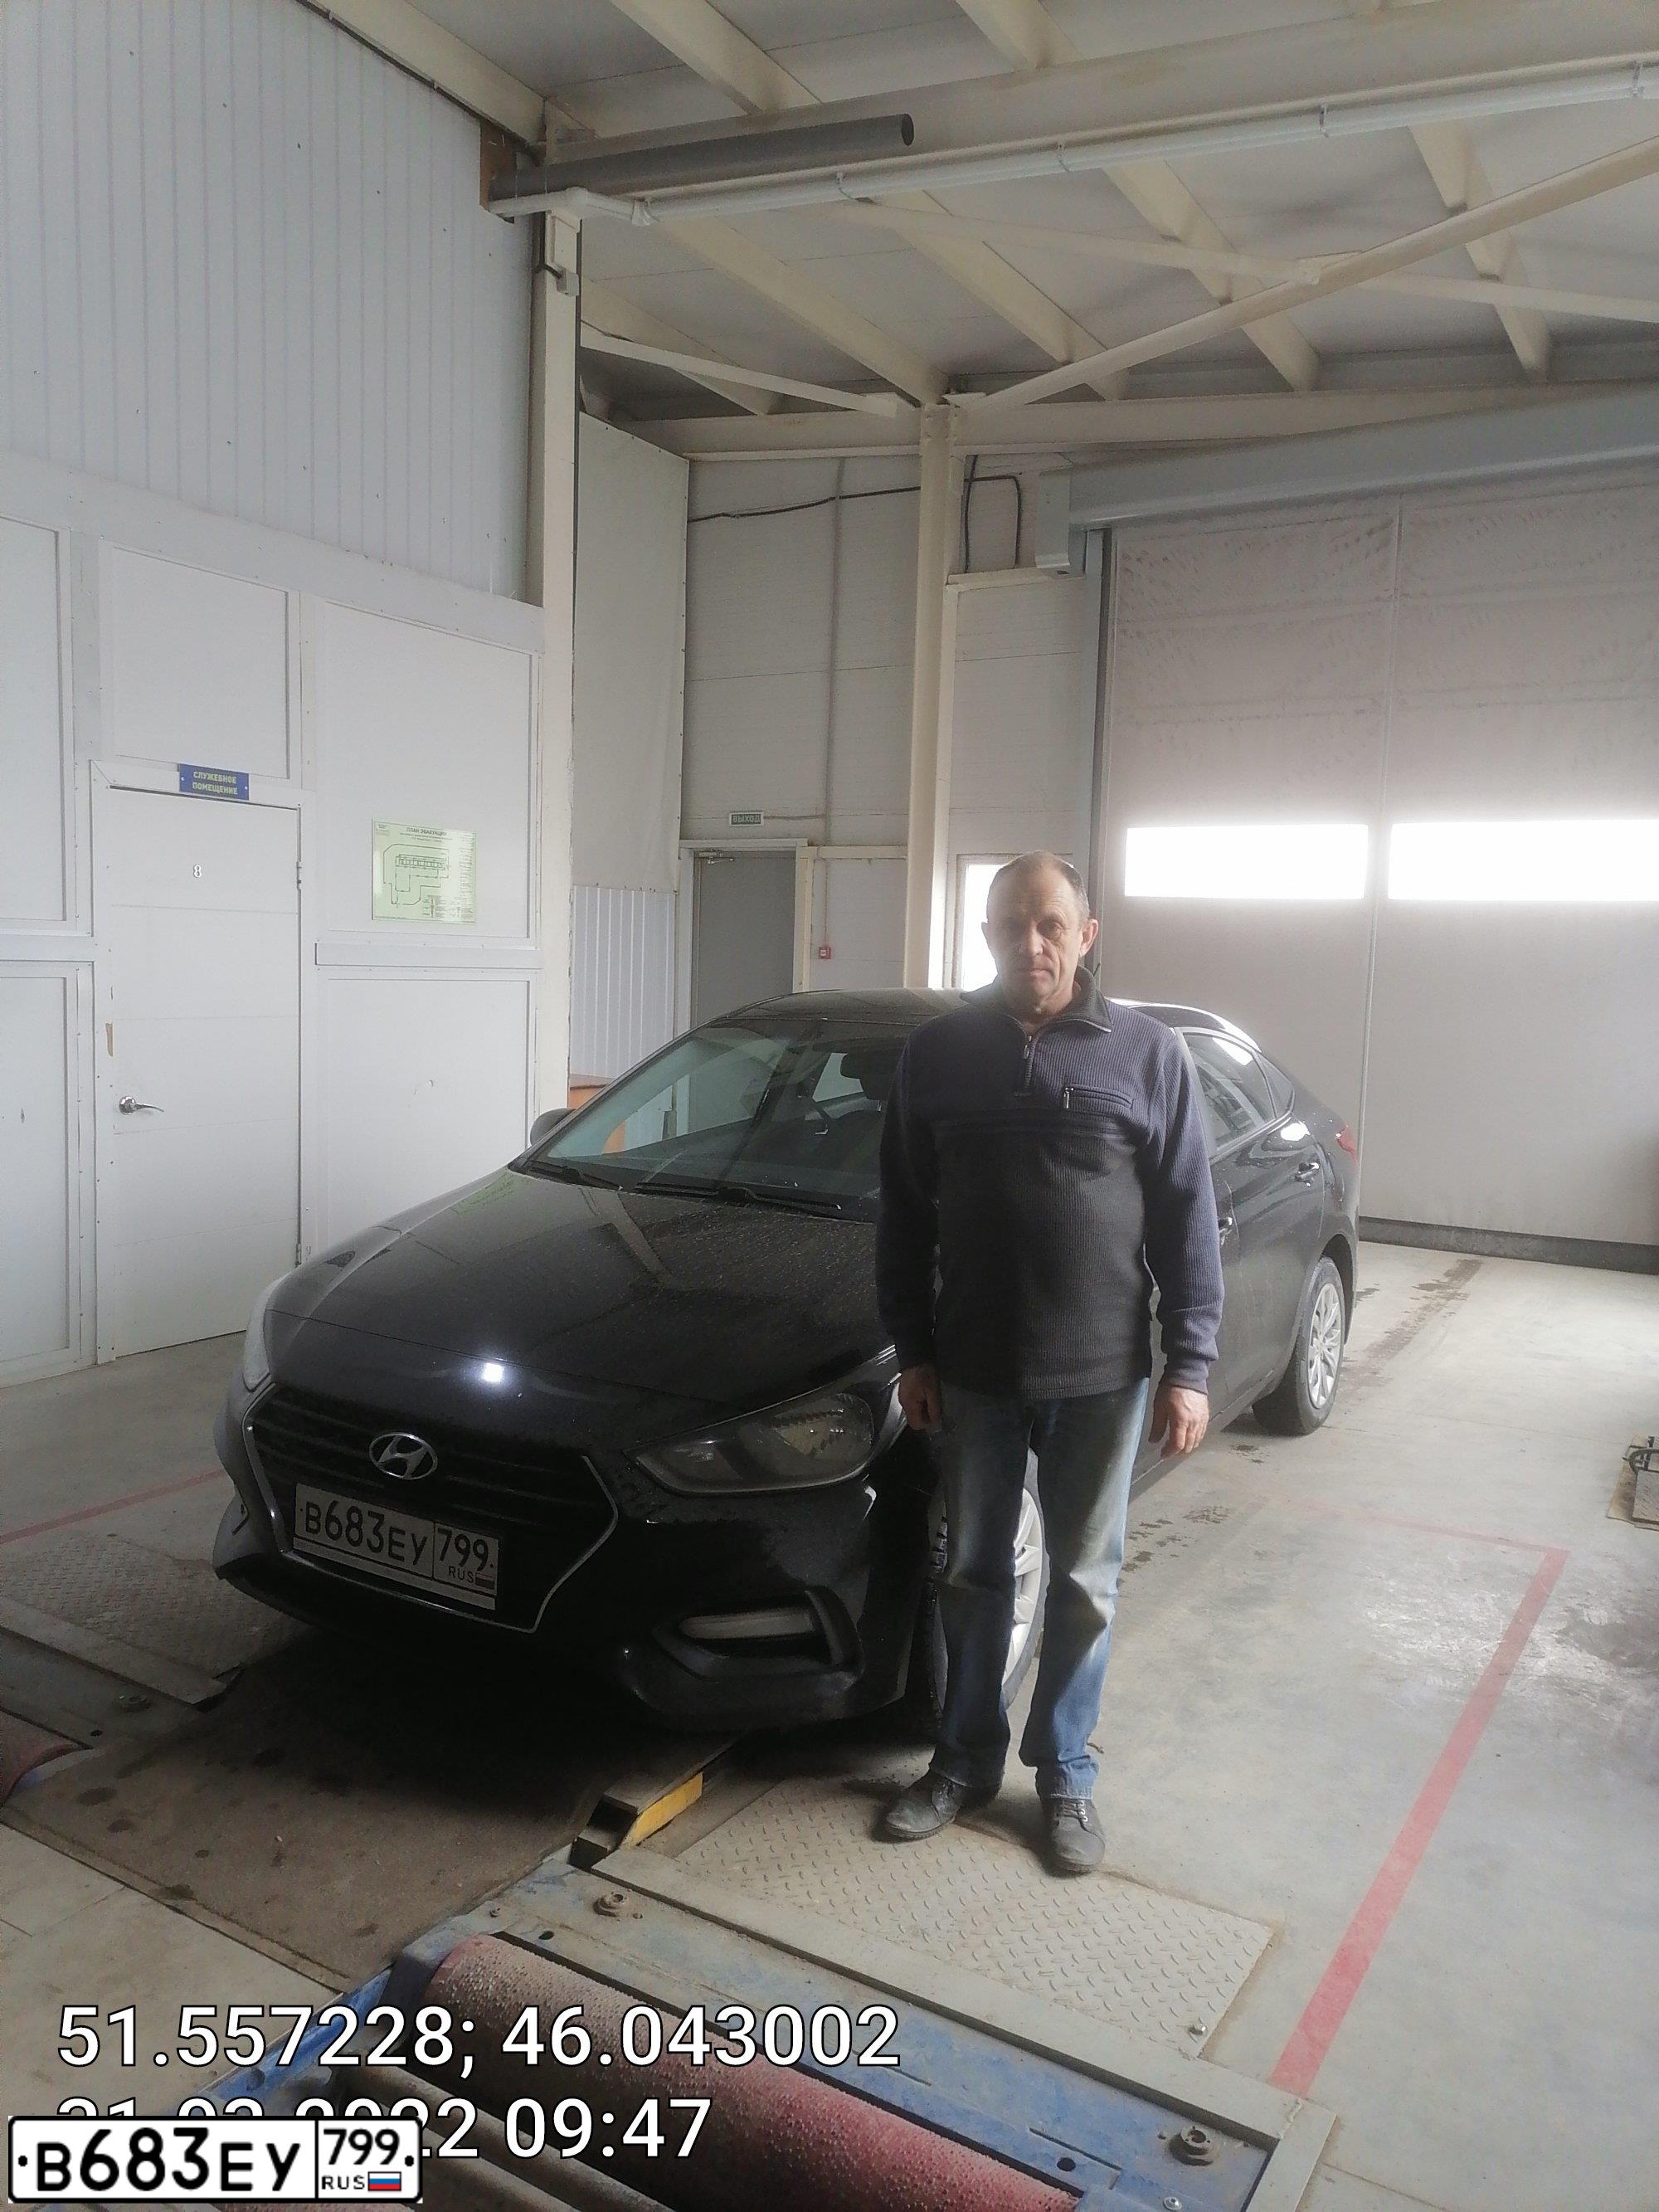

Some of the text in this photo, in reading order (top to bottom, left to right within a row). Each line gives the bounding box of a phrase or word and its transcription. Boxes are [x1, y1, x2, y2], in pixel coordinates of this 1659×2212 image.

[193, 771, 237, 784] СЛУЖЕБНОЕ
[192, 782, 238, 795] ПОМЕЩЕНИЕ
[732, 815, 761, 823] ВЫХОД
[305, 1500, 489, 1571] В683ЕУ 799
[448, 1565, 474, 1584] RUS
